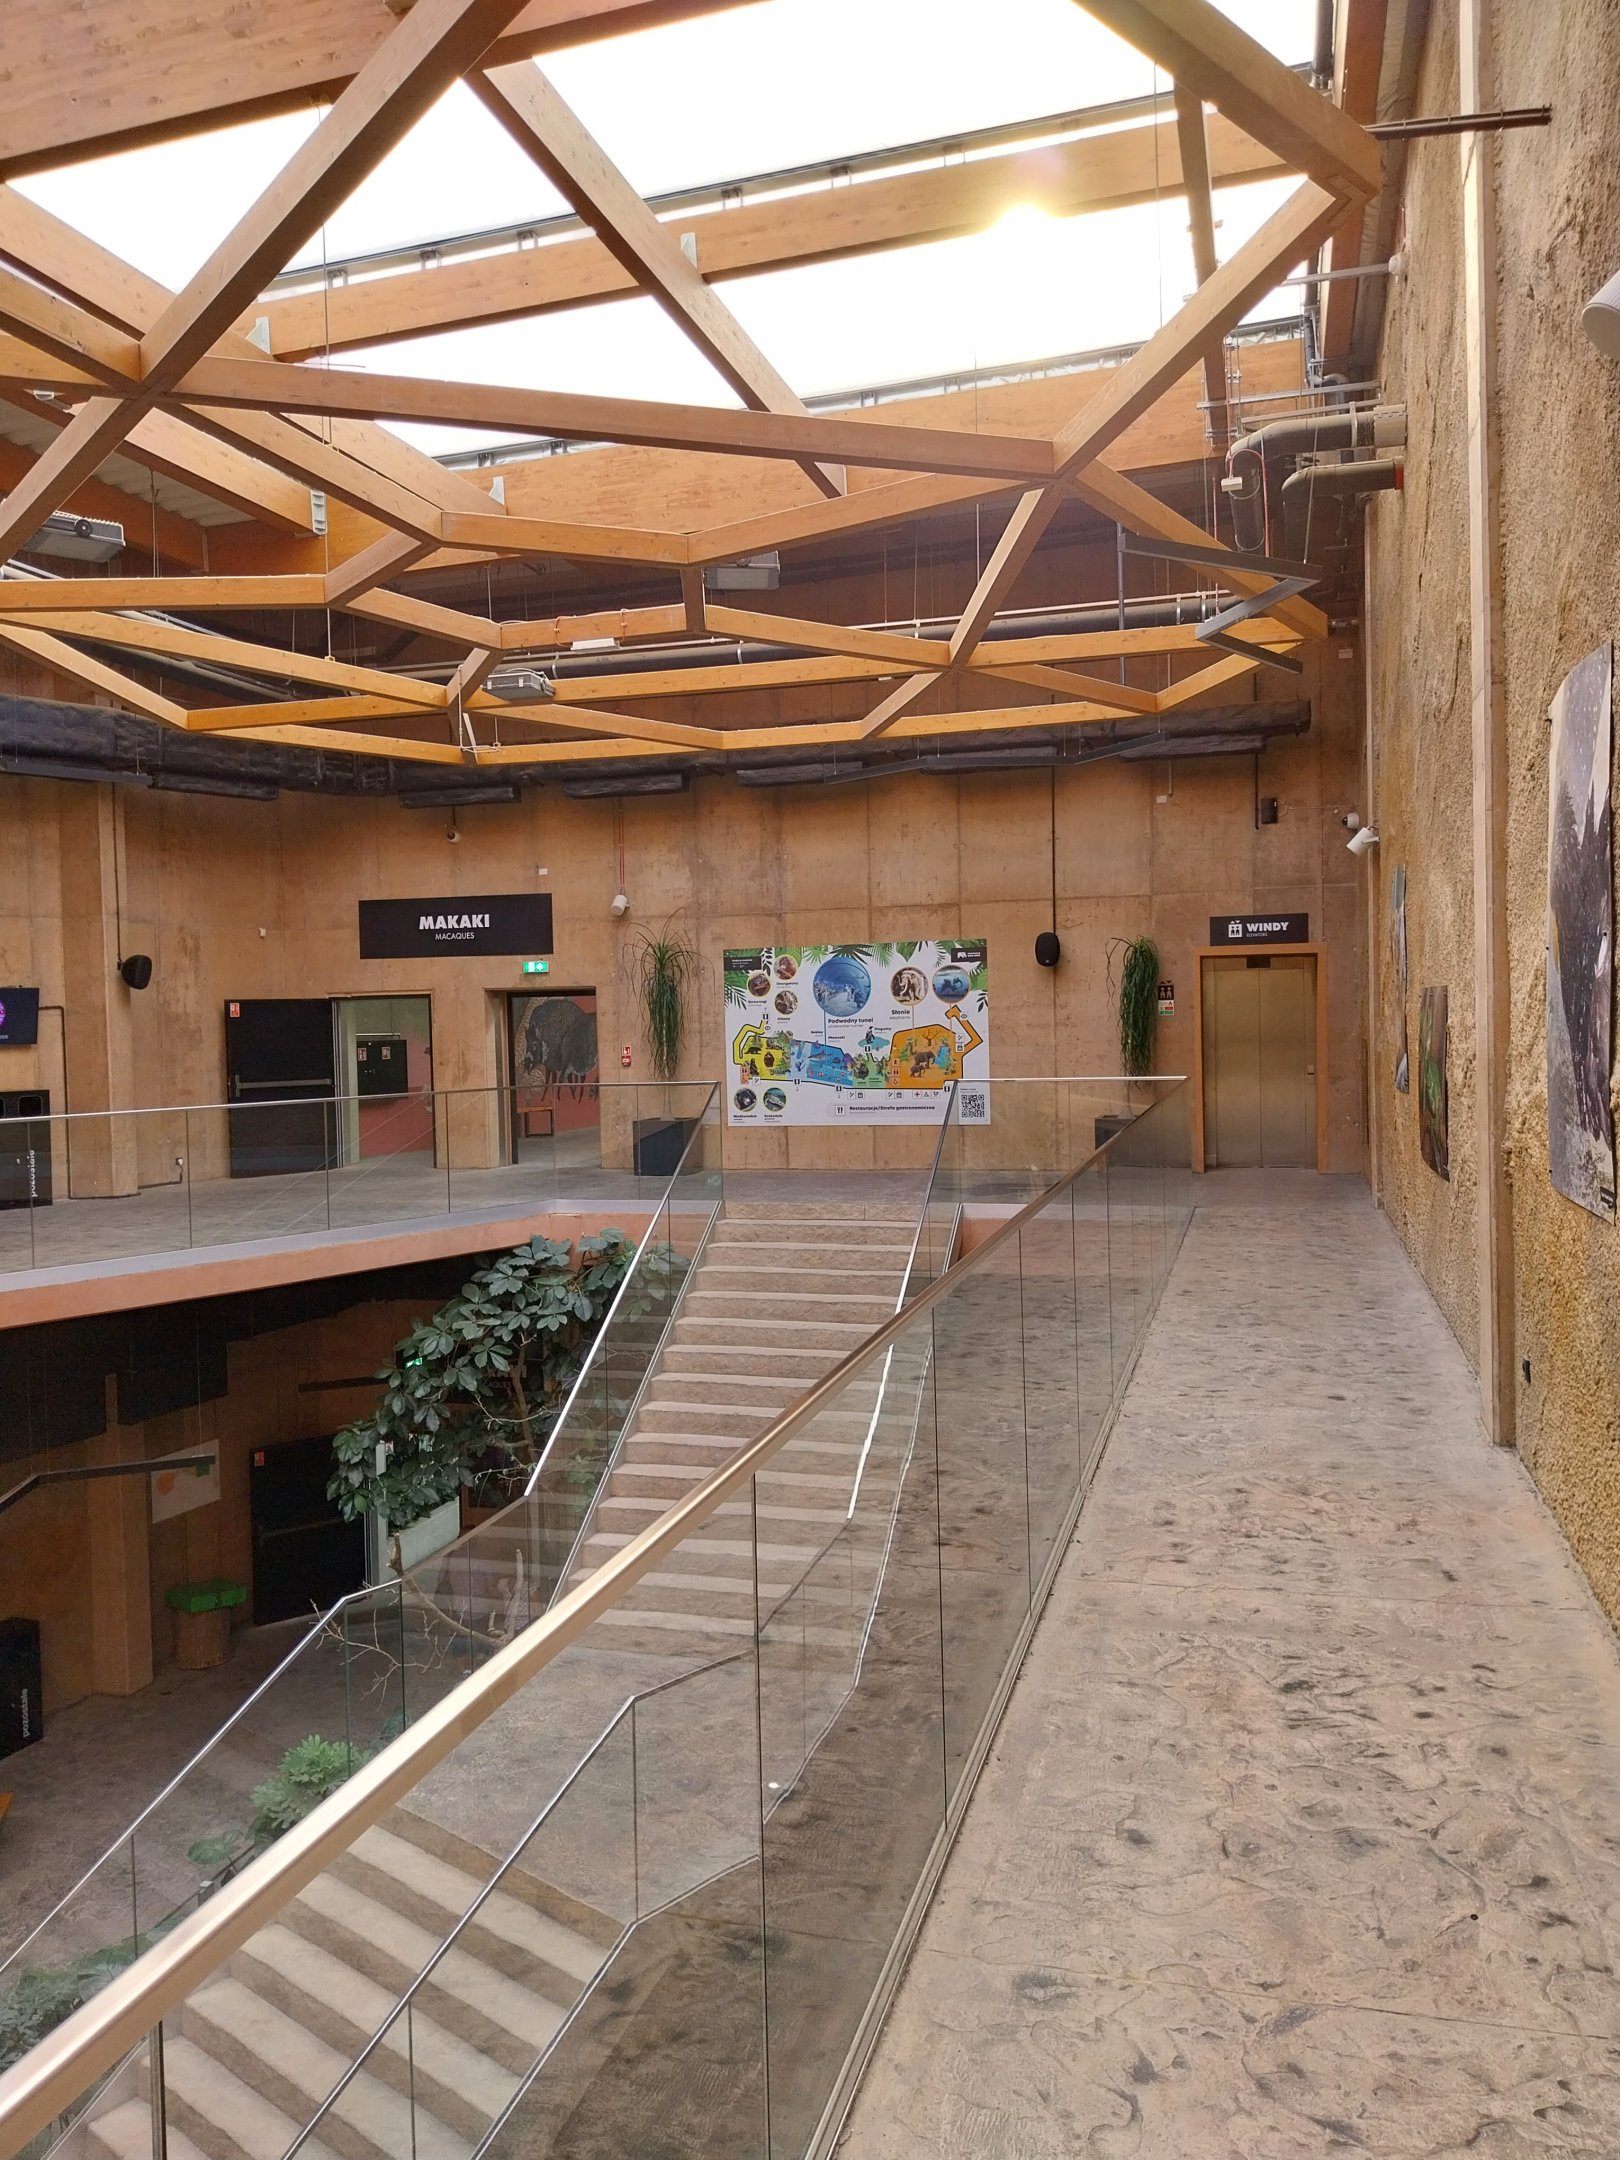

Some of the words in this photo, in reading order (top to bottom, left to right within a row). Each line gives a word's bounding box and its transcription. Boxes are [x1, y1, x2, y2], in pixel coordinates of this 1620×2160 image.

[419, 914, 490, 929] MAKAKI
[1246, 922, 1289, 932] WINDY
[435, 932, 475, 940] MACAQUES
[828, 1017, 858, 1025] Podwodny
